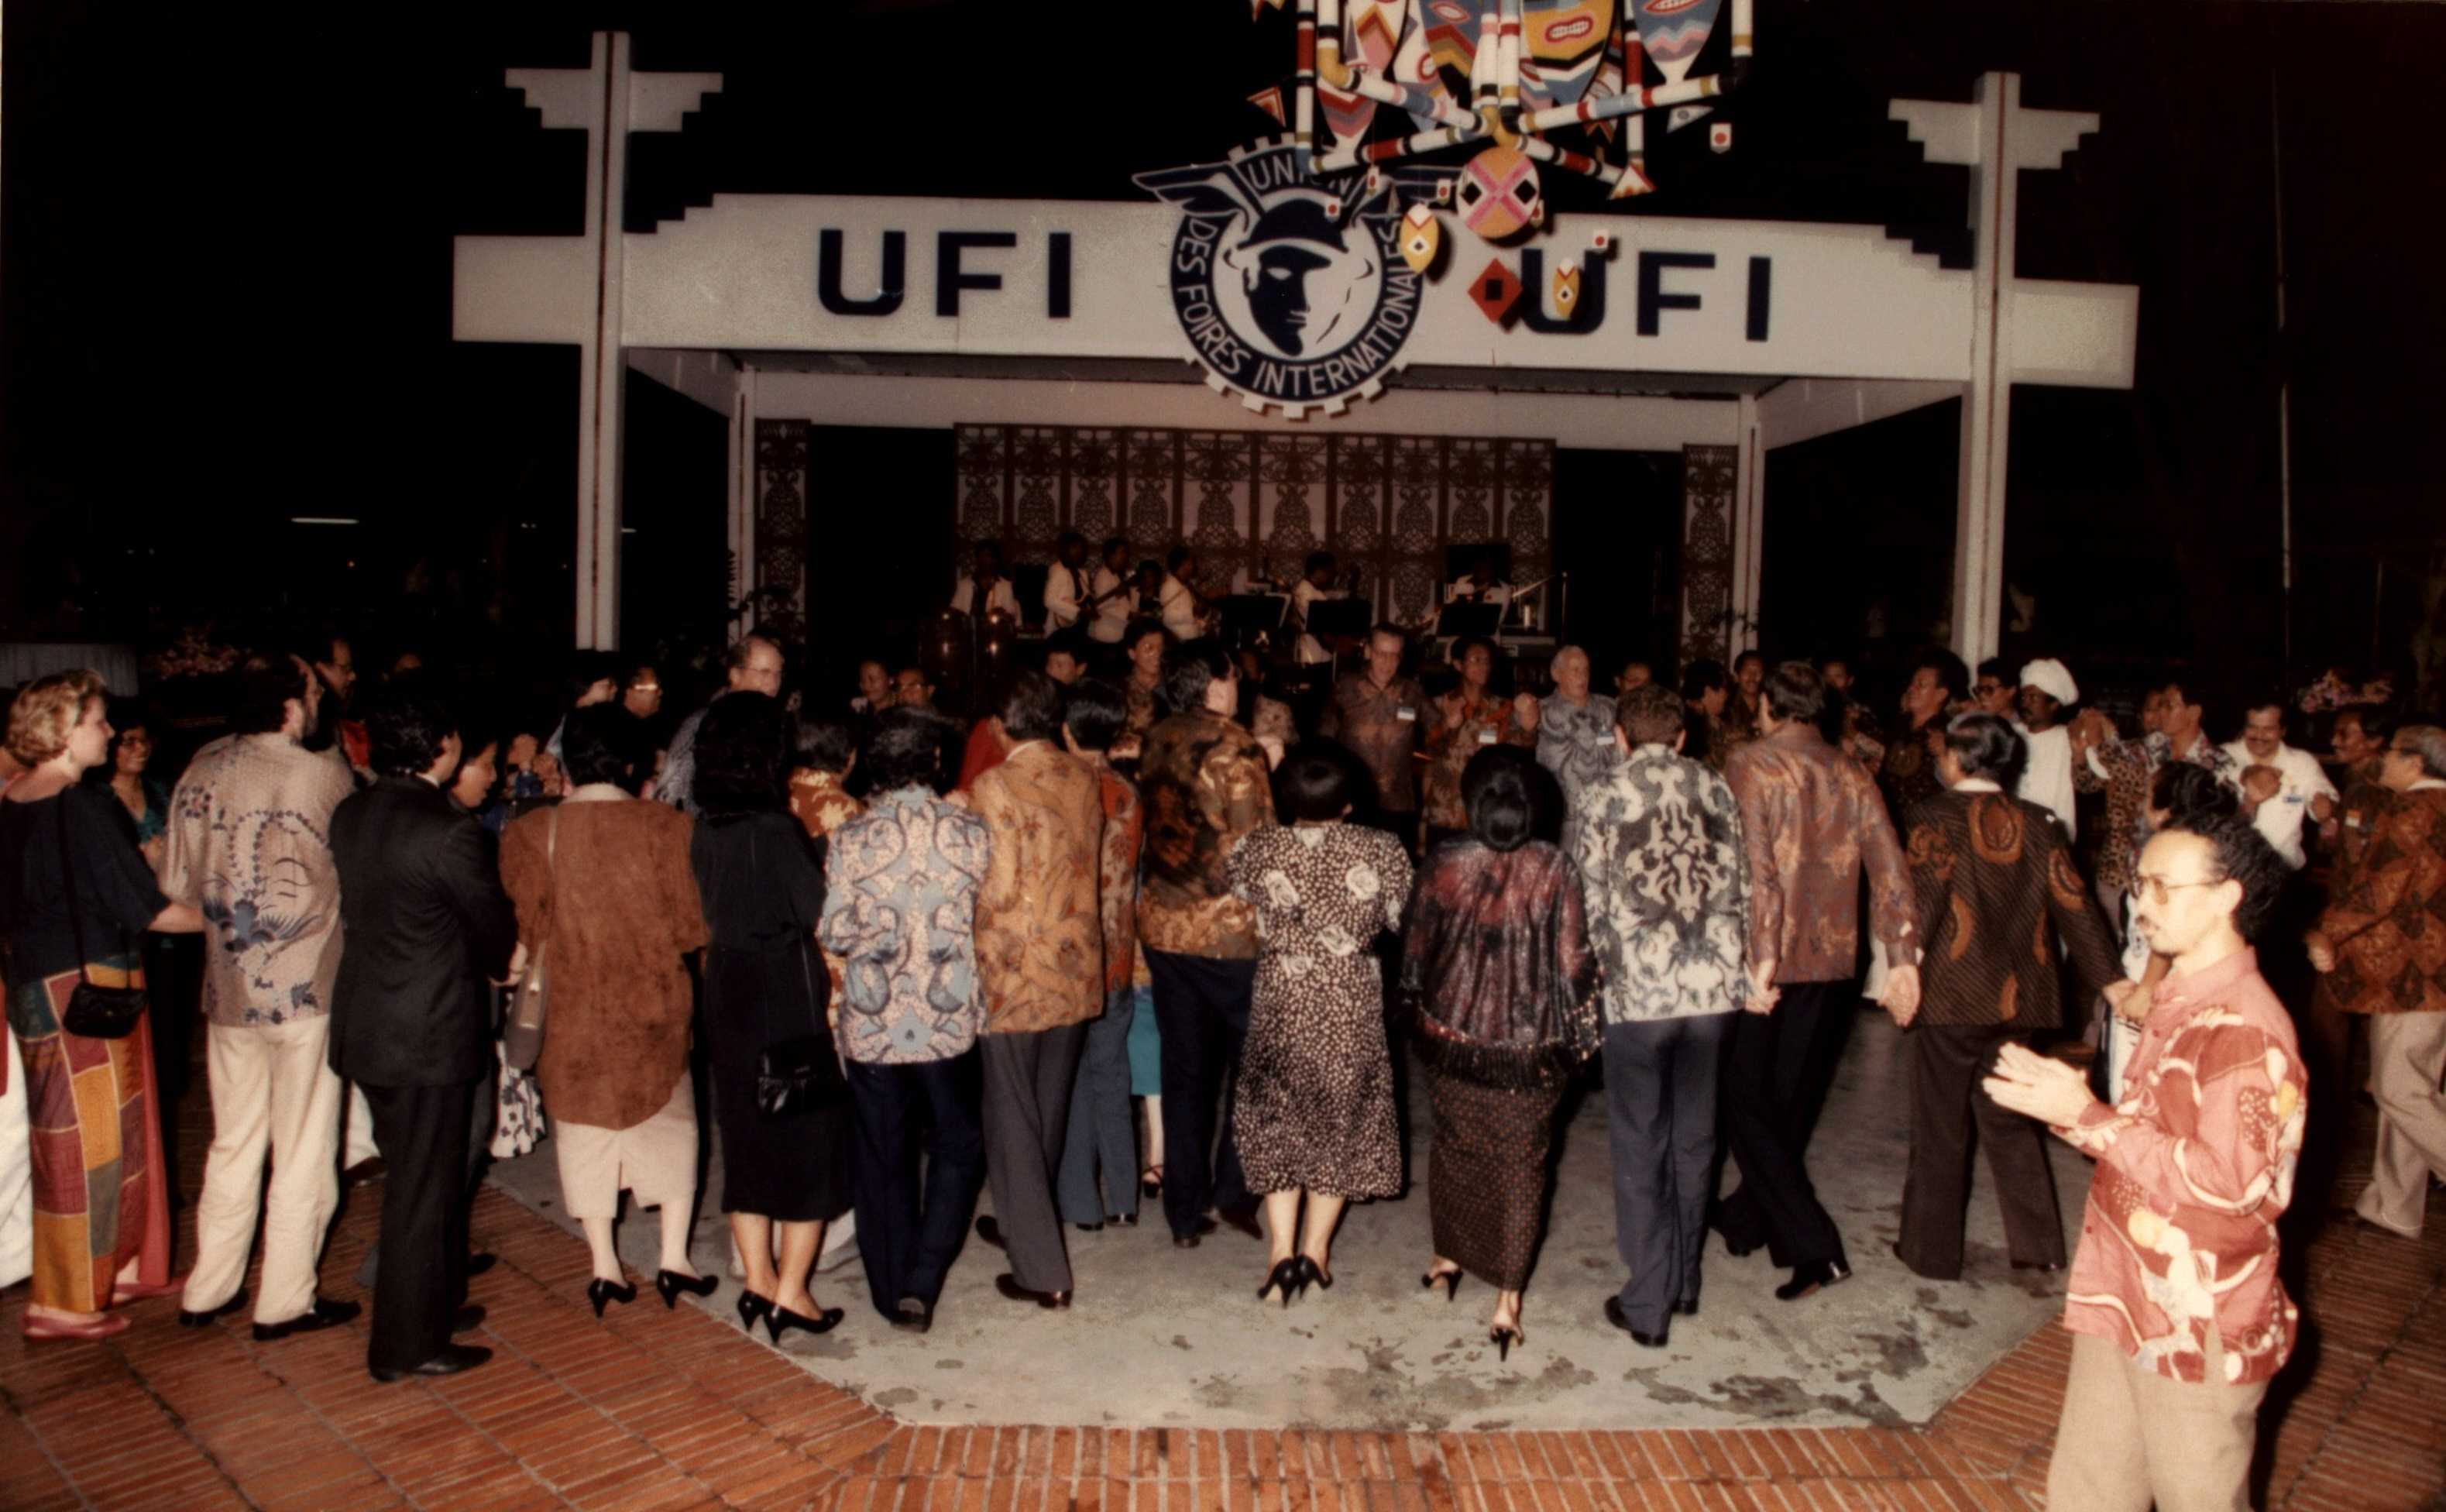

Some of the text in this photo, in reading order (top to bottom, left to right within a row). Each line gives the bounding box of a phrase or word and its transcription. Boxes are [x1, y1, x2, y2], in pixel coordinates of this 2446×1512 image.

[818, 229, 1071, 318] UFI
[1177, 218, 1218, 276] DES
[1177, 284, 1252, 374] FOIRES
[1521, 248, 1771, 342] UFI
